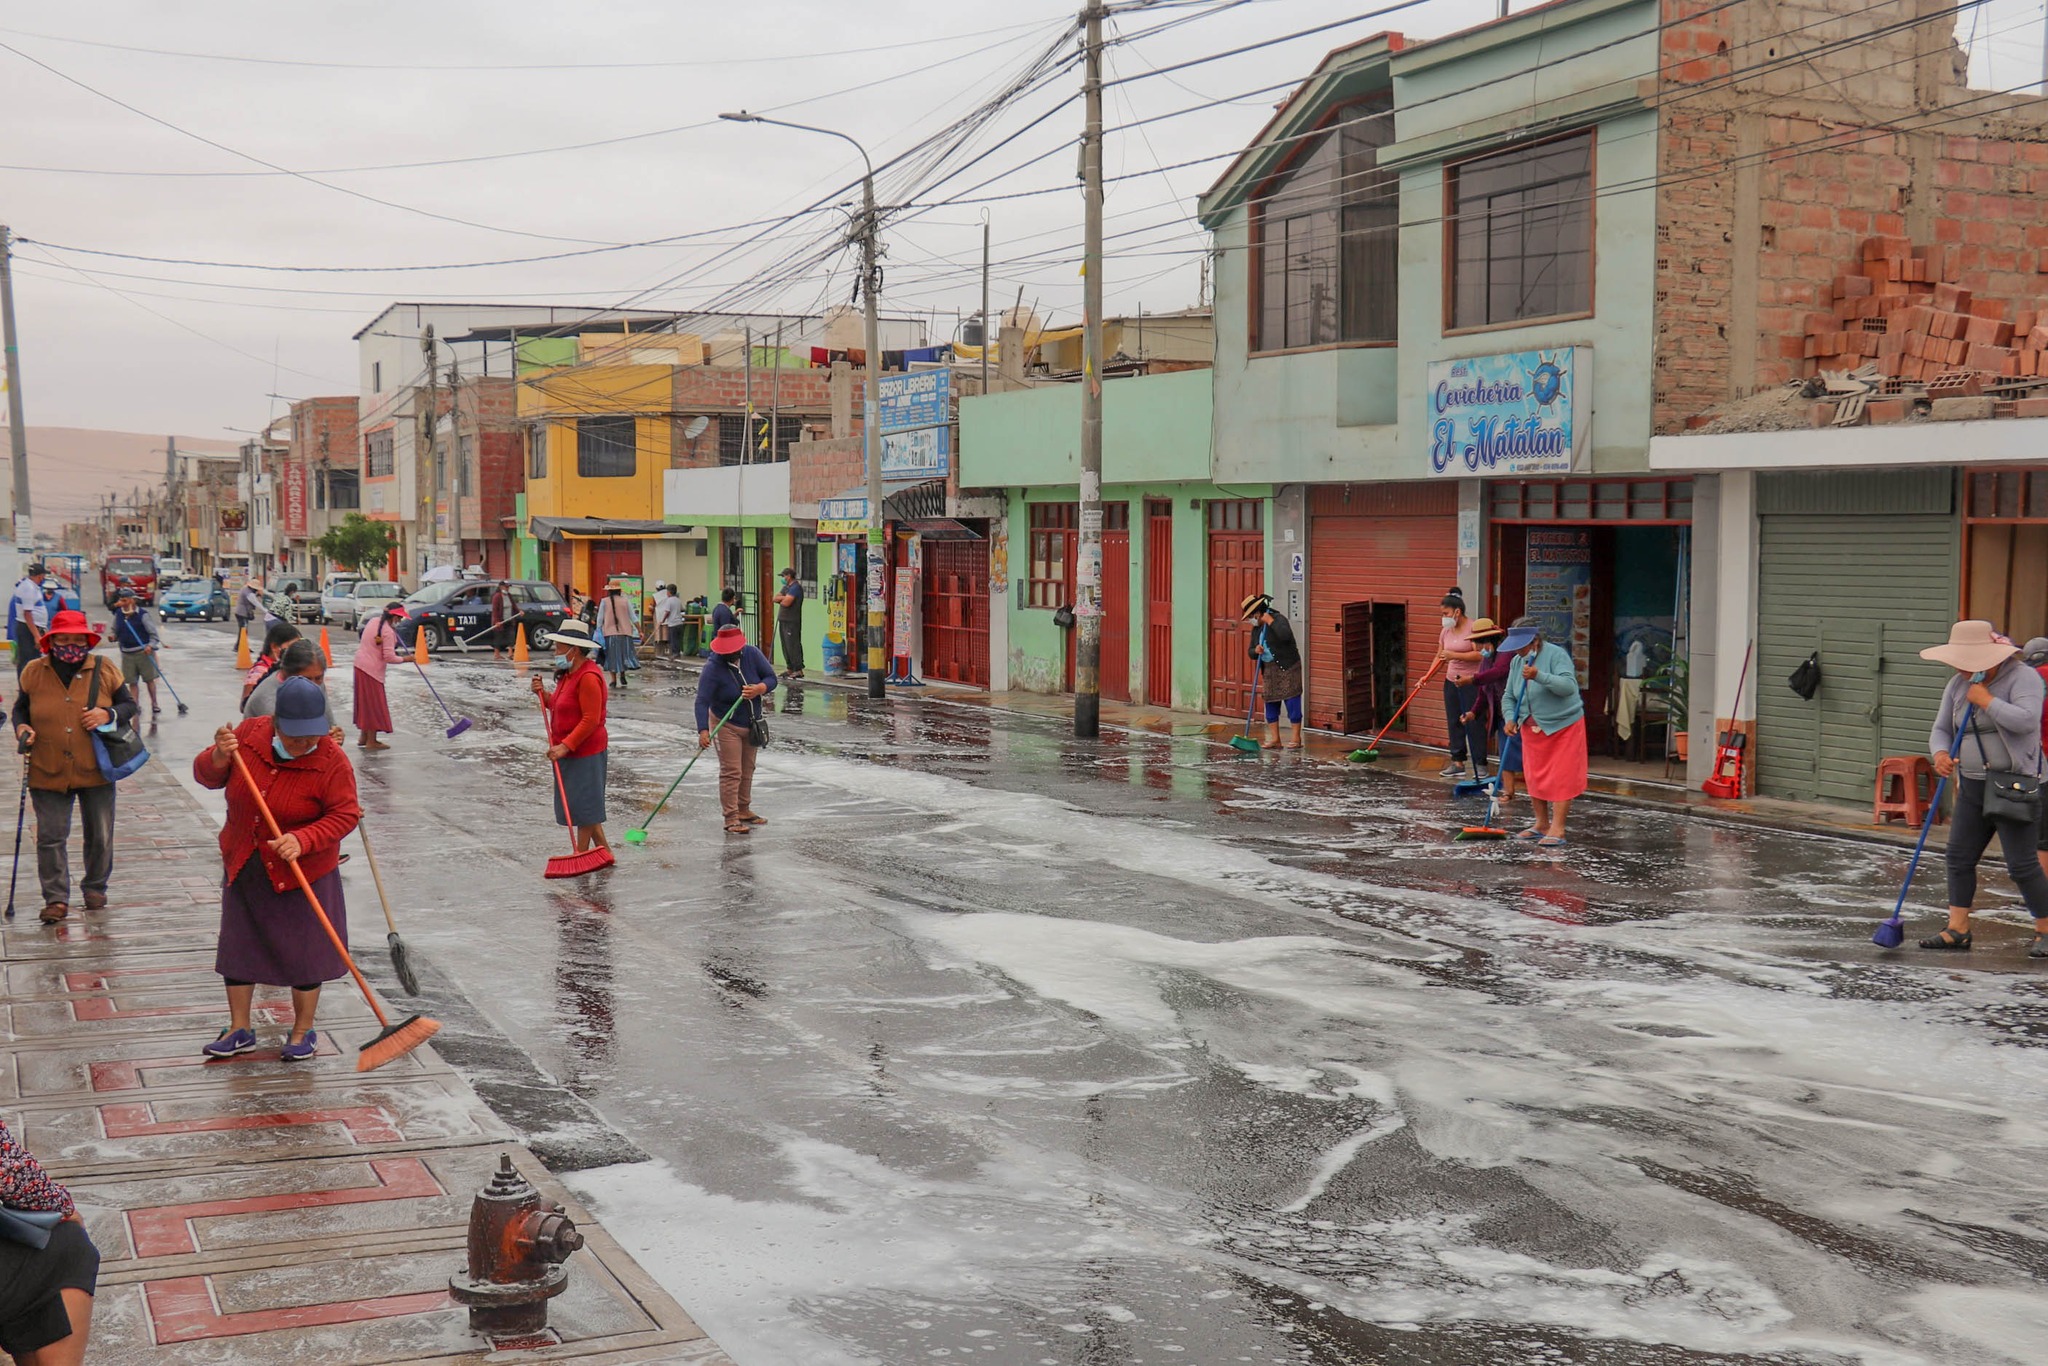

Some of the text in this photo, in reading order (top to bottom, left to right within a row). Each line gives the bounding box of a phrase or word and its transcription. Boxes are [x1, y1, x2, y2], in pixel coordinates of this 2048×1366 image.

[879, 380, 903, 398] BAZAR
[1435, 377, 1523, 415] Cevicheria
[1432, 413, 1566, 473] El Matatan
[1529, 548, 1541, 562] EL
[458, 615, 477, 625] TAXI
